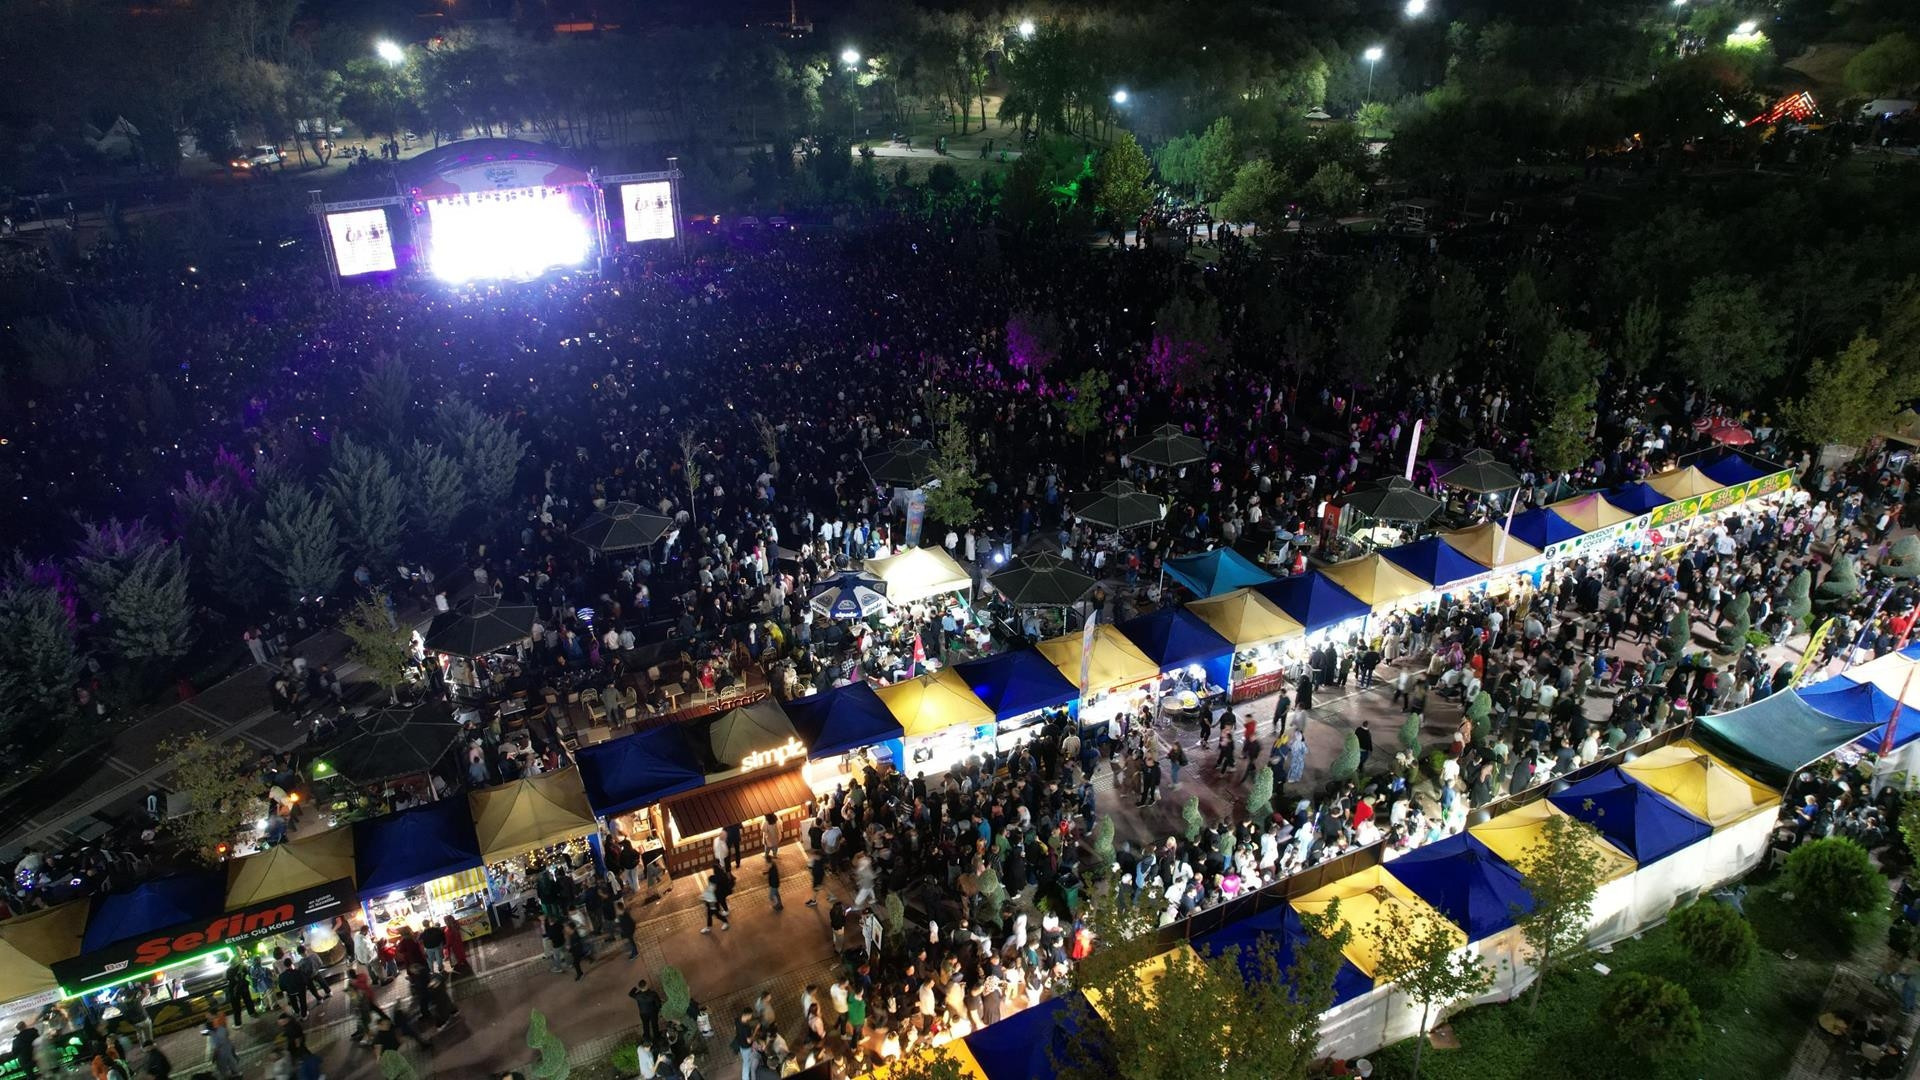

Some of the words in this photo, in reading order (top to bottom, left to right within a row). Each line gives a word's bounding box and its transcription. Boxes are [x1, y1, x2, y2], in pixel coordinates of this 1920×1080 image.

[134, 903, 295, 966] Şefim
[225, 934, 249, 944] Etsiz
[251, 928, 268, 937] Çiğ
[269, 919, 295, 931] Köfte
[105, 960, 128, 971] Bay
